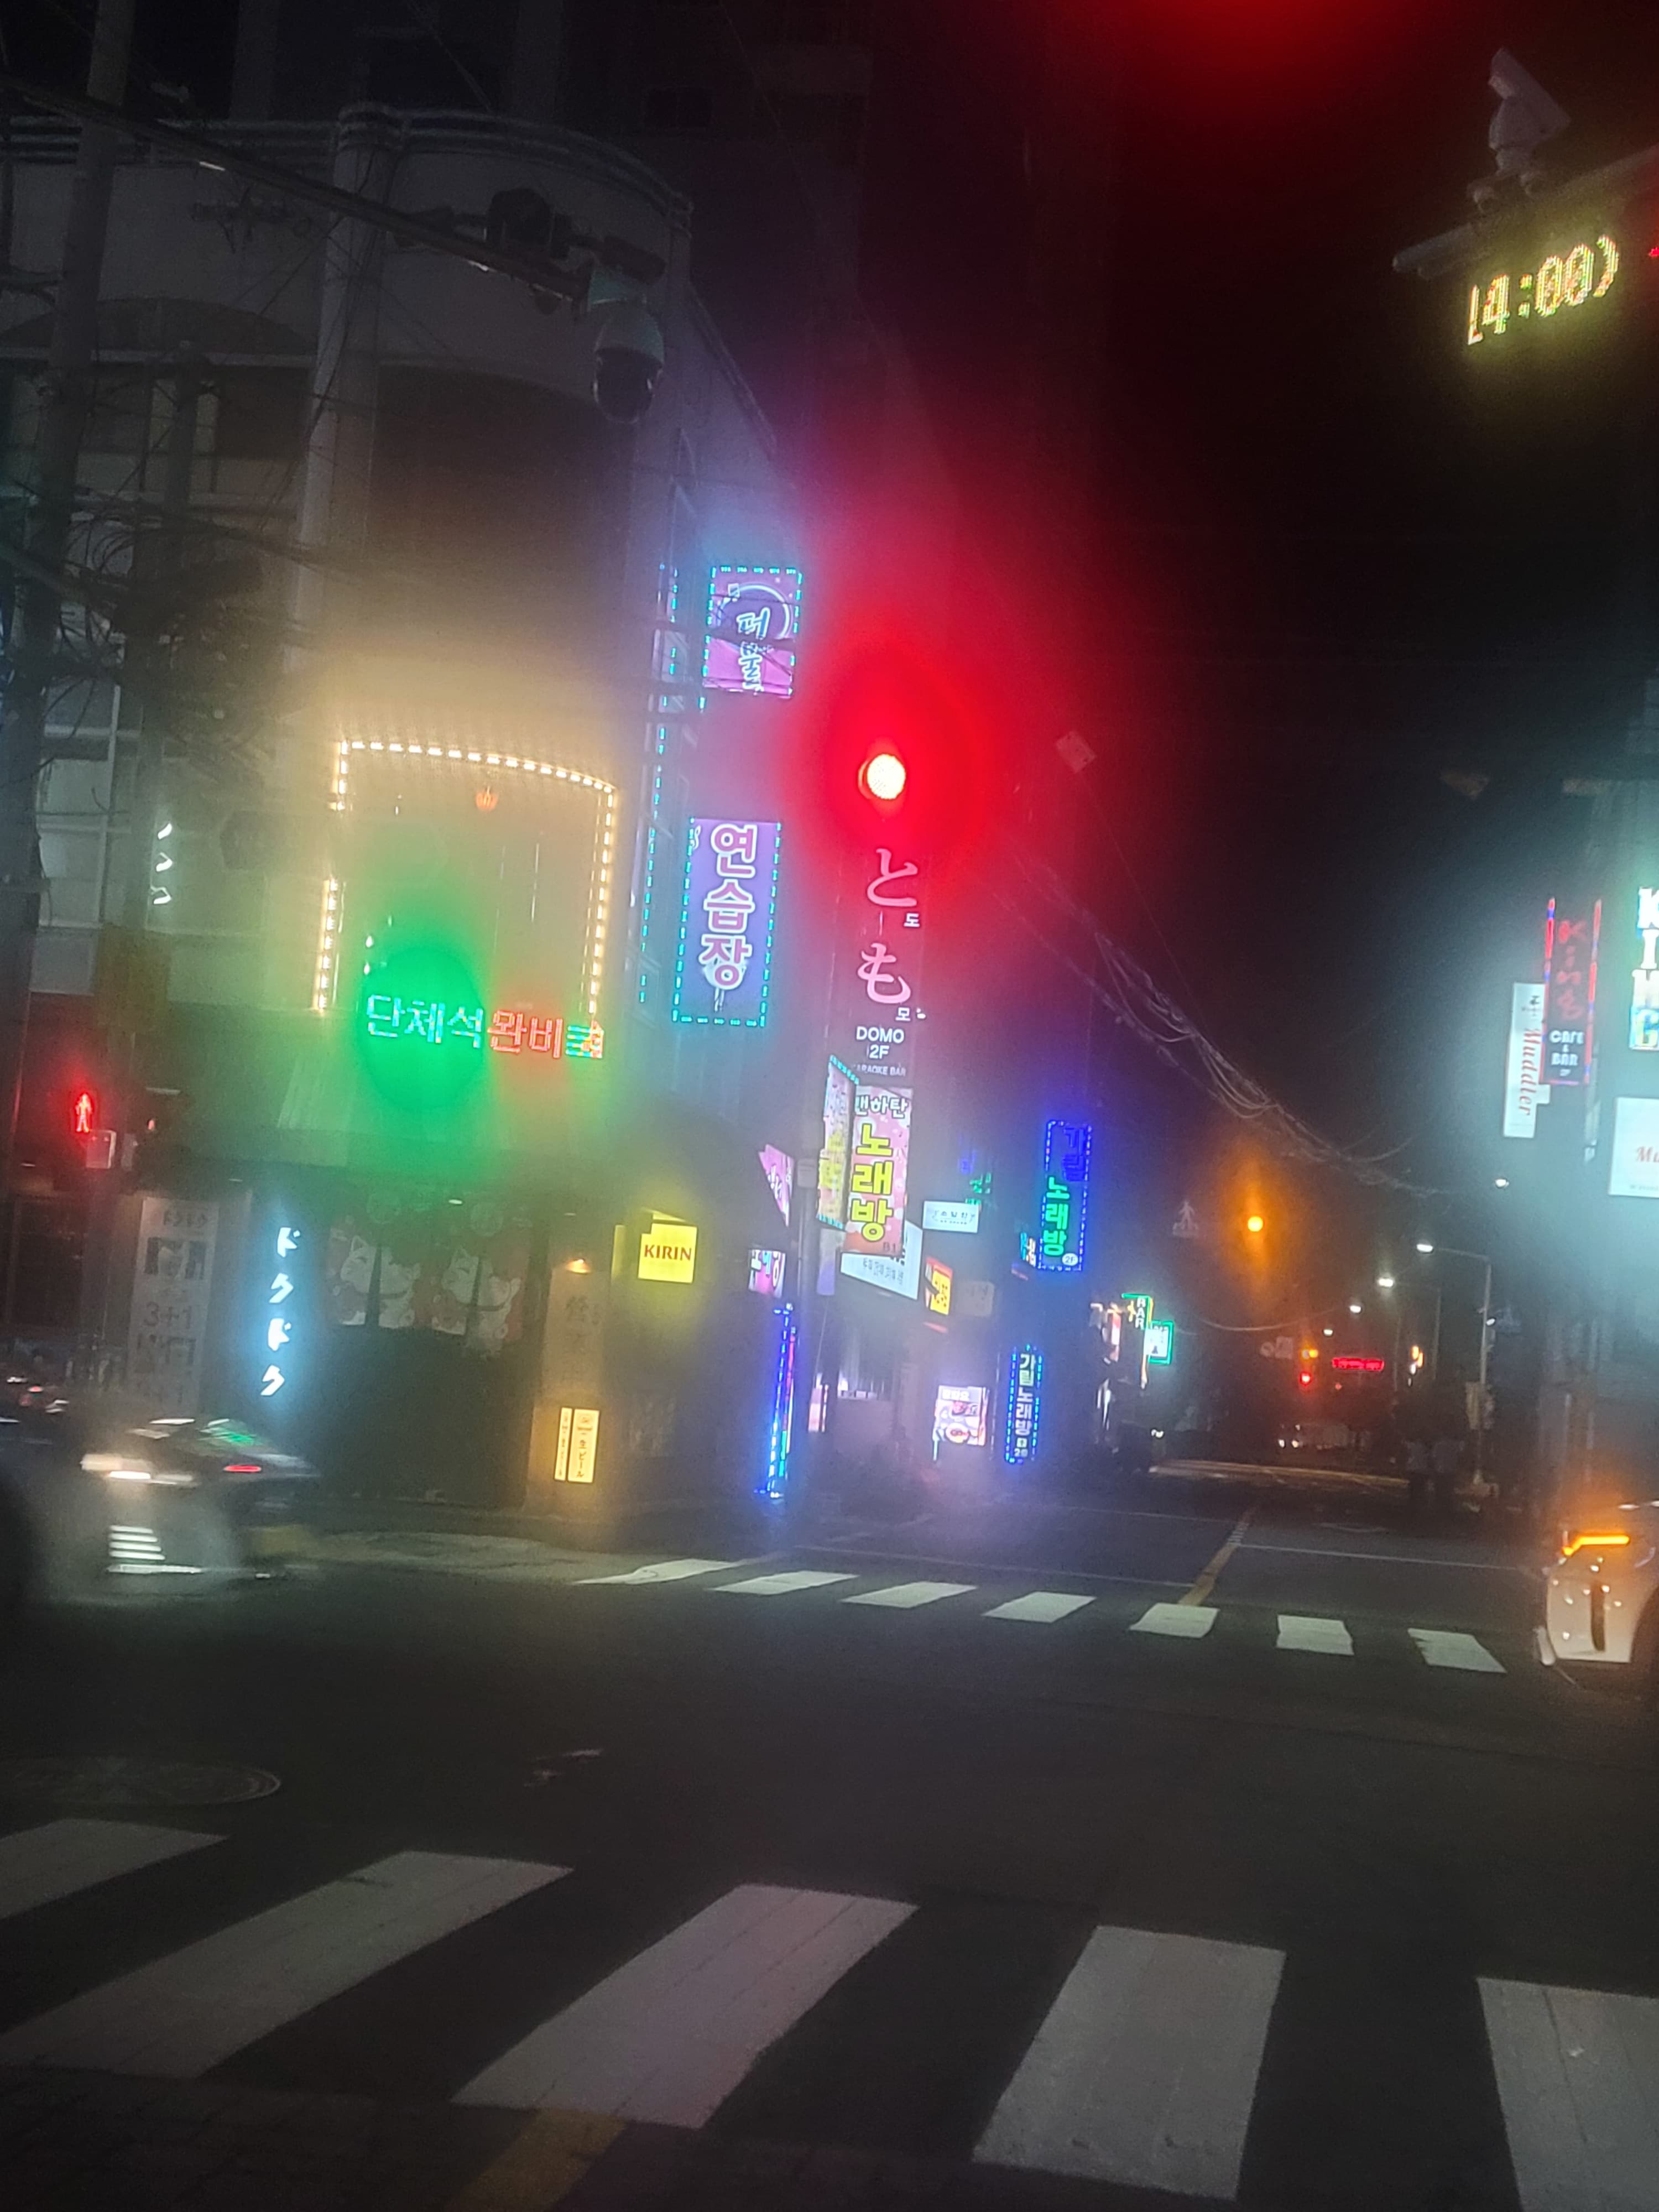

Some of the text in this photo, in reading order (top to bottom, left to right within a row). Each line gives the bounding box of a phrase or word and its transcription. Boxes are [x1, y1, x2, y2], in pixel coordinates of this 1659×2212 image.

[698, 823, 758, 990] 연습장
[367, 994, 484, 1049] 단체석
[488, 1010, 564, 1060] 완비
[856, 1026, 905, 1044] DOMO
[869, 1044, 889, 1060] 2F
[854, 1063, 888, 1076] ARAOKE
[1518, 1027, 1541, 1116] Muddler
[855, 1094, 909, 1119] 맨하탄
[850, 1123, 894, 1242] 노래방
[1043, 1176, 1071, 1256] 노래방
[643, 1244, 692, 1261] KIRIN
[260, 1227, 301, 1396] ドクドク
[1015, 1387, 1034, 1436] 노래방
